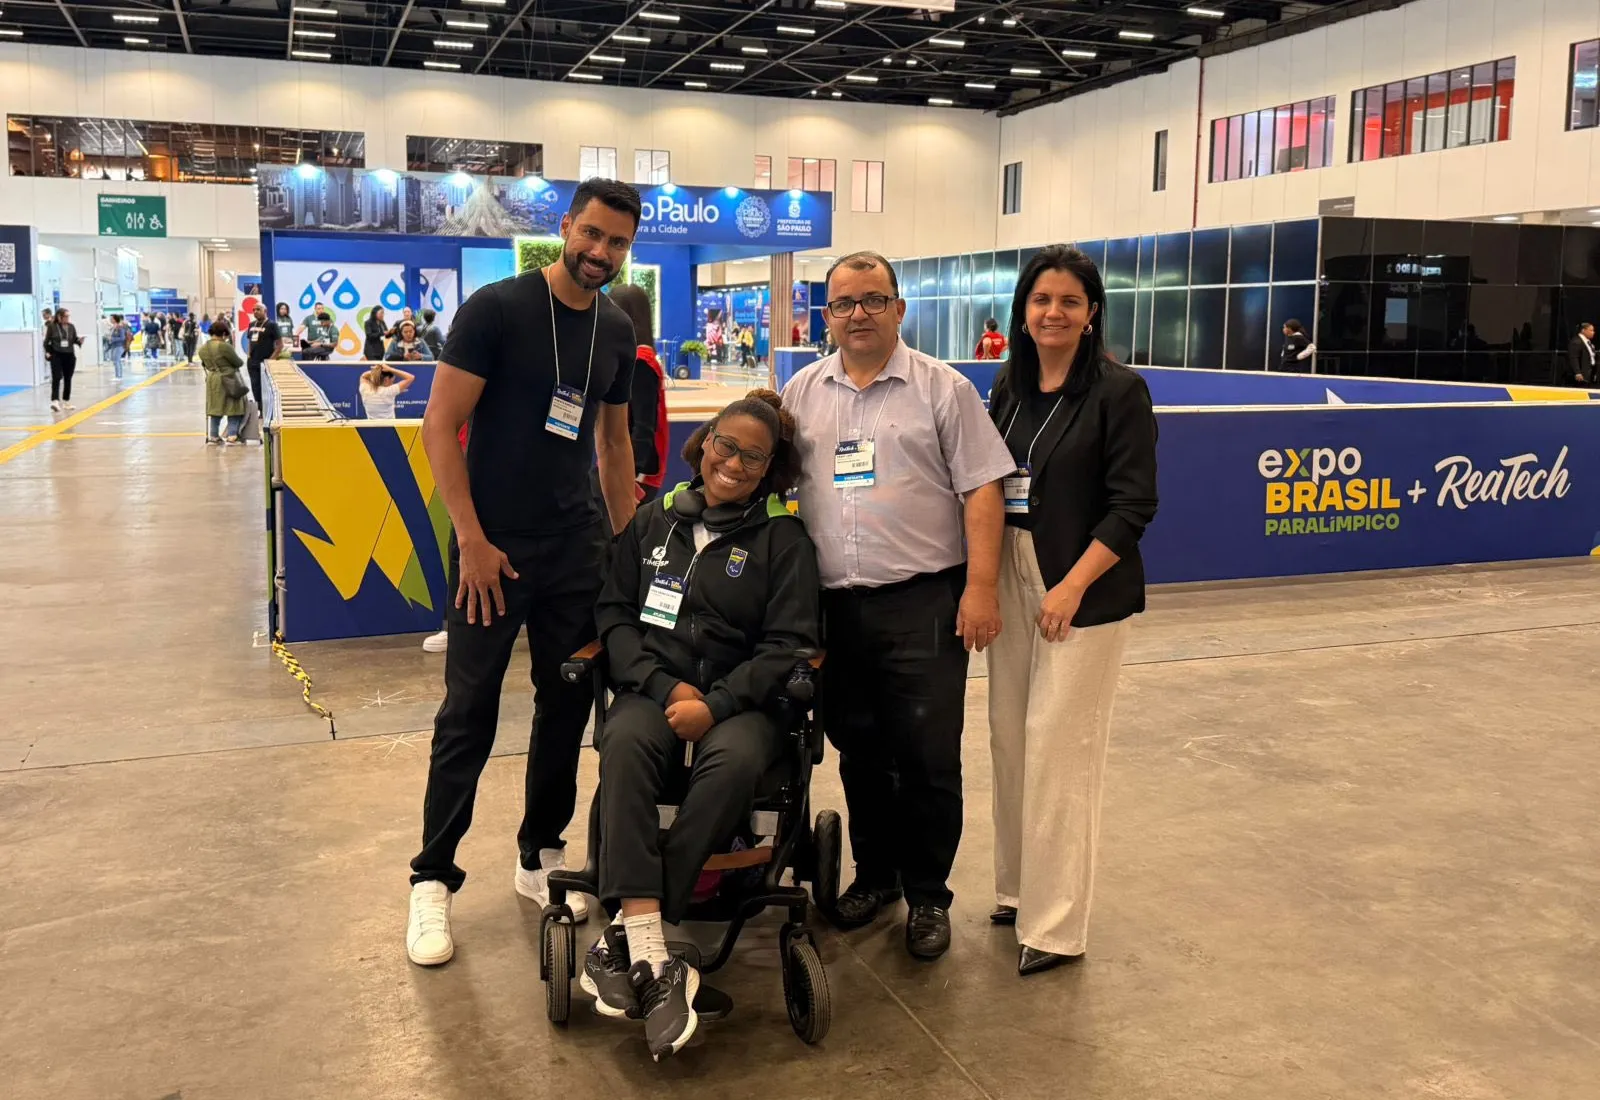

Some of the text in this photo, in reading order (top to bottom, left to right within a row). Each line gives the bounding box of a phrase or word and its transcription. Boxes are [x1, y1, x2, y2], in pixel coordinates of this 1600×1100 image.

[657, 195, 719, 223] Paulo
[658, 224, 688, 234] Cidade
[777, 224, 790, 232] SÃO
[1258, 447, 1362, 485] expo
[1407, 445, 1571, 510] + ReaTech
[1265, 478, 1401, 514] BRASIL
